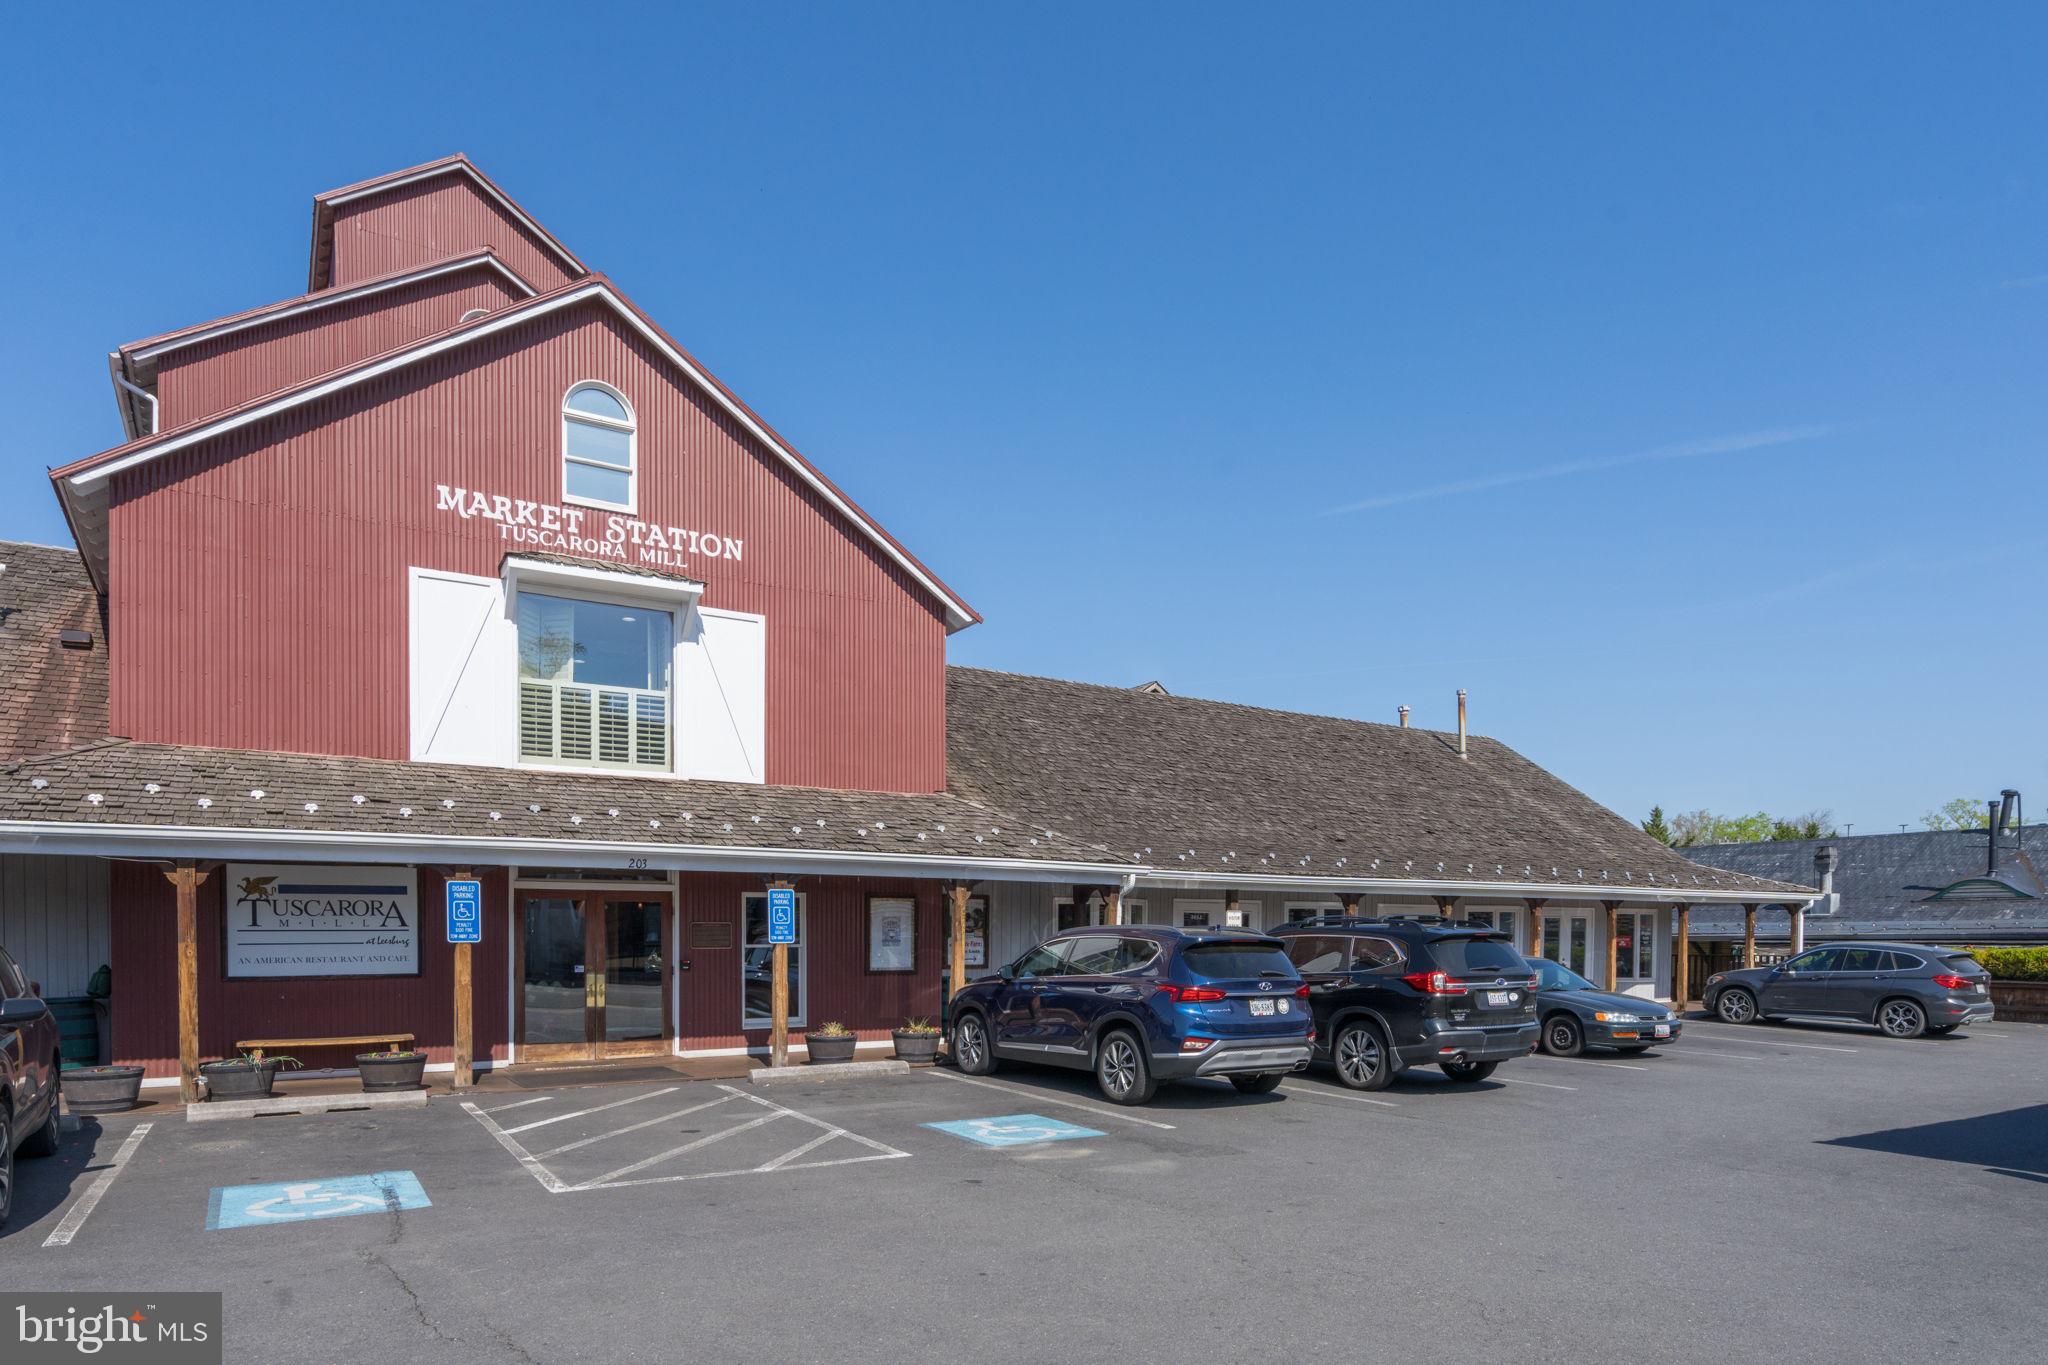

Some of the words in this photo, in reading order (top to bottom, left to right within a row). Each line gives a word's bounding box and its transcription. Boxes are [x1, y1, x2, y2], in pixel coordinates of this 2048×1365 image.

[436, 485, 583, 533] MARKET
[606, 516, 744, 561] STATION
[496, 524, 627, 559] TUSCARORA
[639, 547, 688, 568] MILL
[628, 858, 648, 869] 203
[236, 899, 409, 927] TUSCARORA
[365, 937, 376, 945] at
[376, 935, 411, 948] Leesburg
[239, 957, 251, 965] AN
[253, 956, 303, 964] AMERICAN
[305, 955, 364, 964] RESTAURANT
[367, 955, 386, 963] AND
